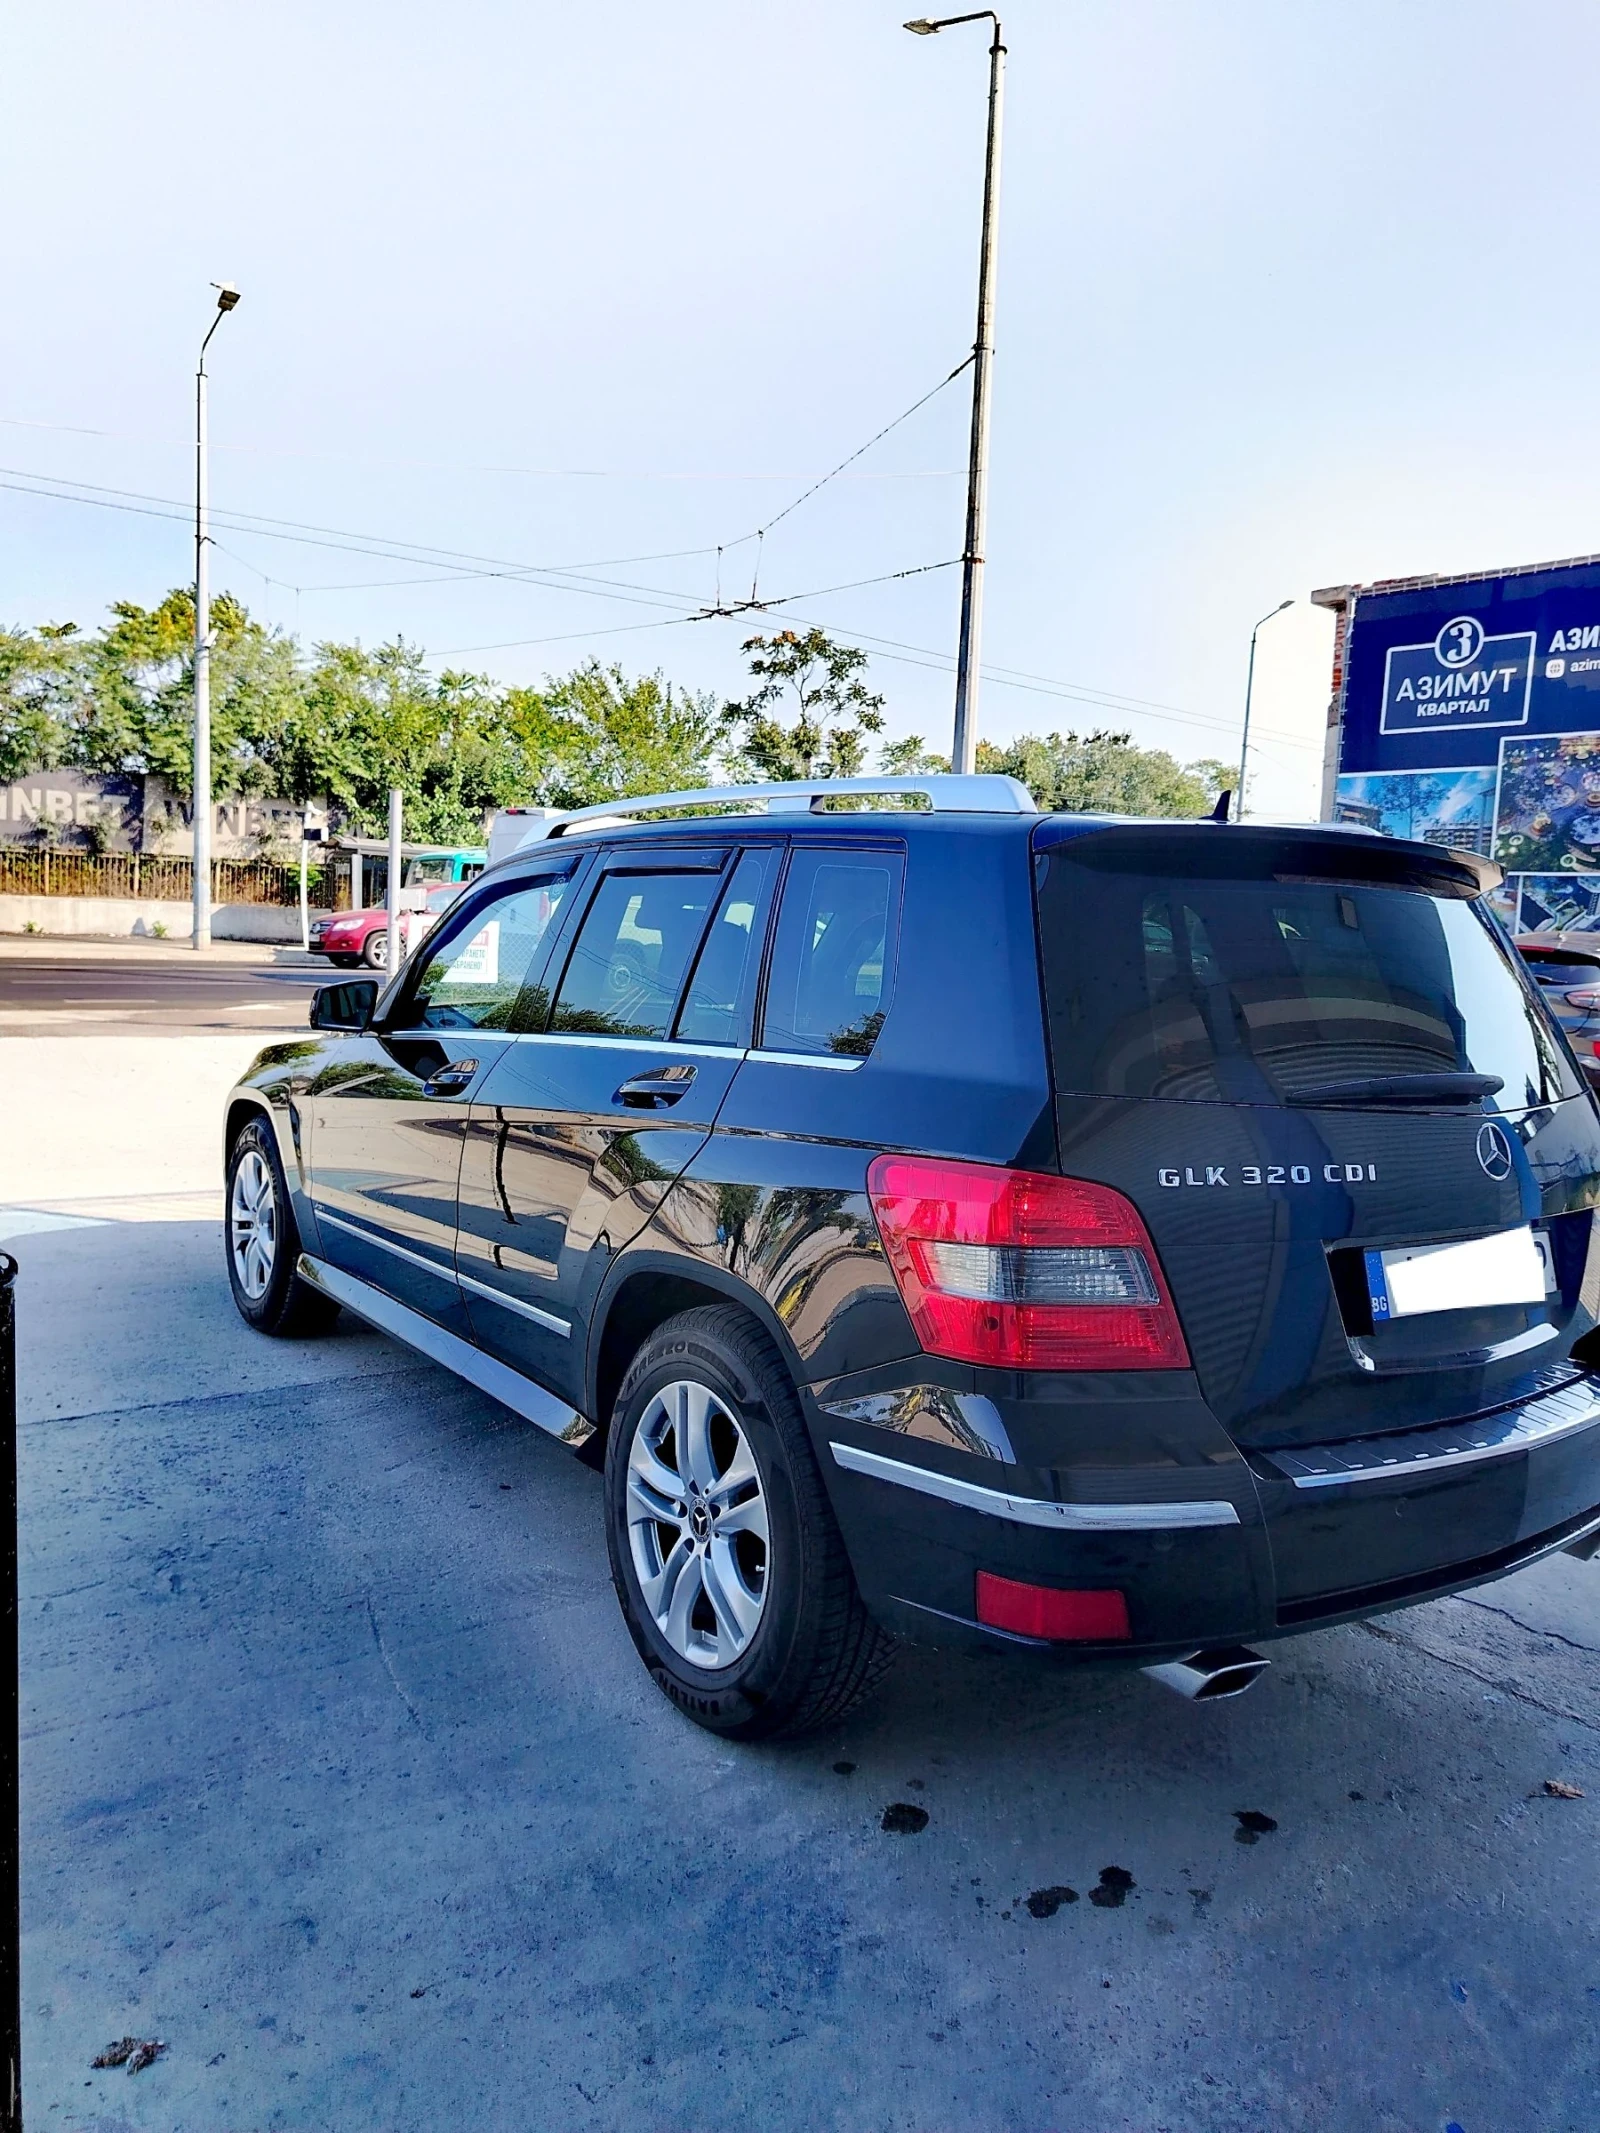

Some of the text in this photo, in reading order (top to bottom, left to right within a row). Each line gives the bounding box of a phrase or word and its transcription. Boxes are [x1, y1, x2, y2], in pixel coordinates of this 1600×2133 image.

[1548, 625, 1600, 652] АЗИ
[1395, 668, 1517, 702] АЗИМУТ
[1416, 699, 1490, 717] КВАРТАЛ
[1158, 1164, 1377, 1187] GLK 320 CDI
[1371, 1295, 1388, 1313] BG
